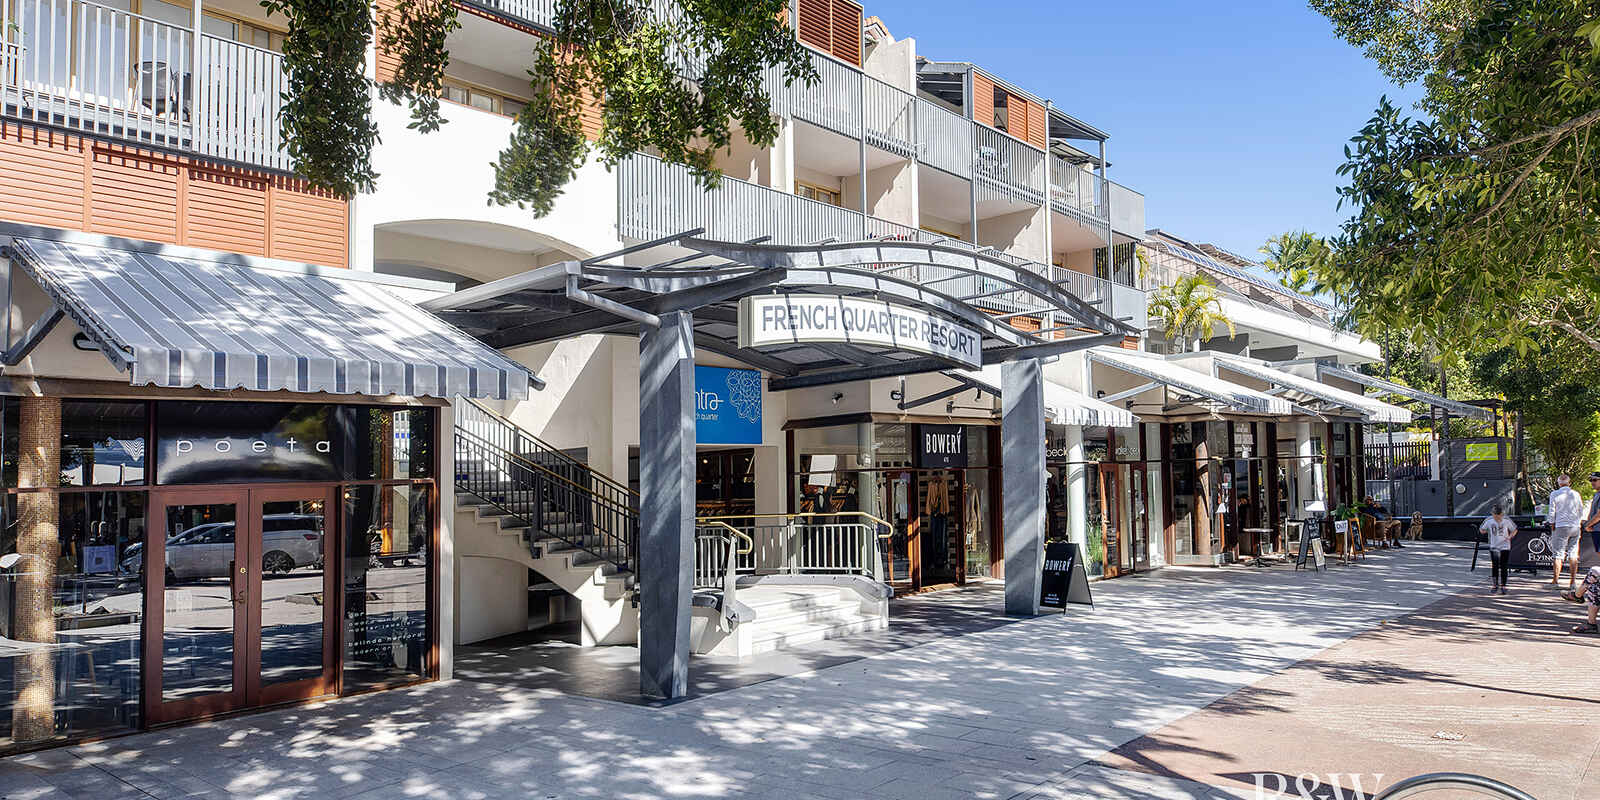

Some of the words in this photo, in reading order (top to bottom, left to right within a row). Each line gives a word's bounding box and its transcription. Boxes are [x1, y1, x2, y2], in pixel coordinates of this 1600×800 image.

[762, 304, 837, 332] FRENCH
[842, 307, 918, 340] QUARTER
[921, 321, 975, 357] RESORT
[176, 437, 330, 457] poeta
[926, 426, 962, 454] BOWERY
[348, 638, 382, 647] belinda
